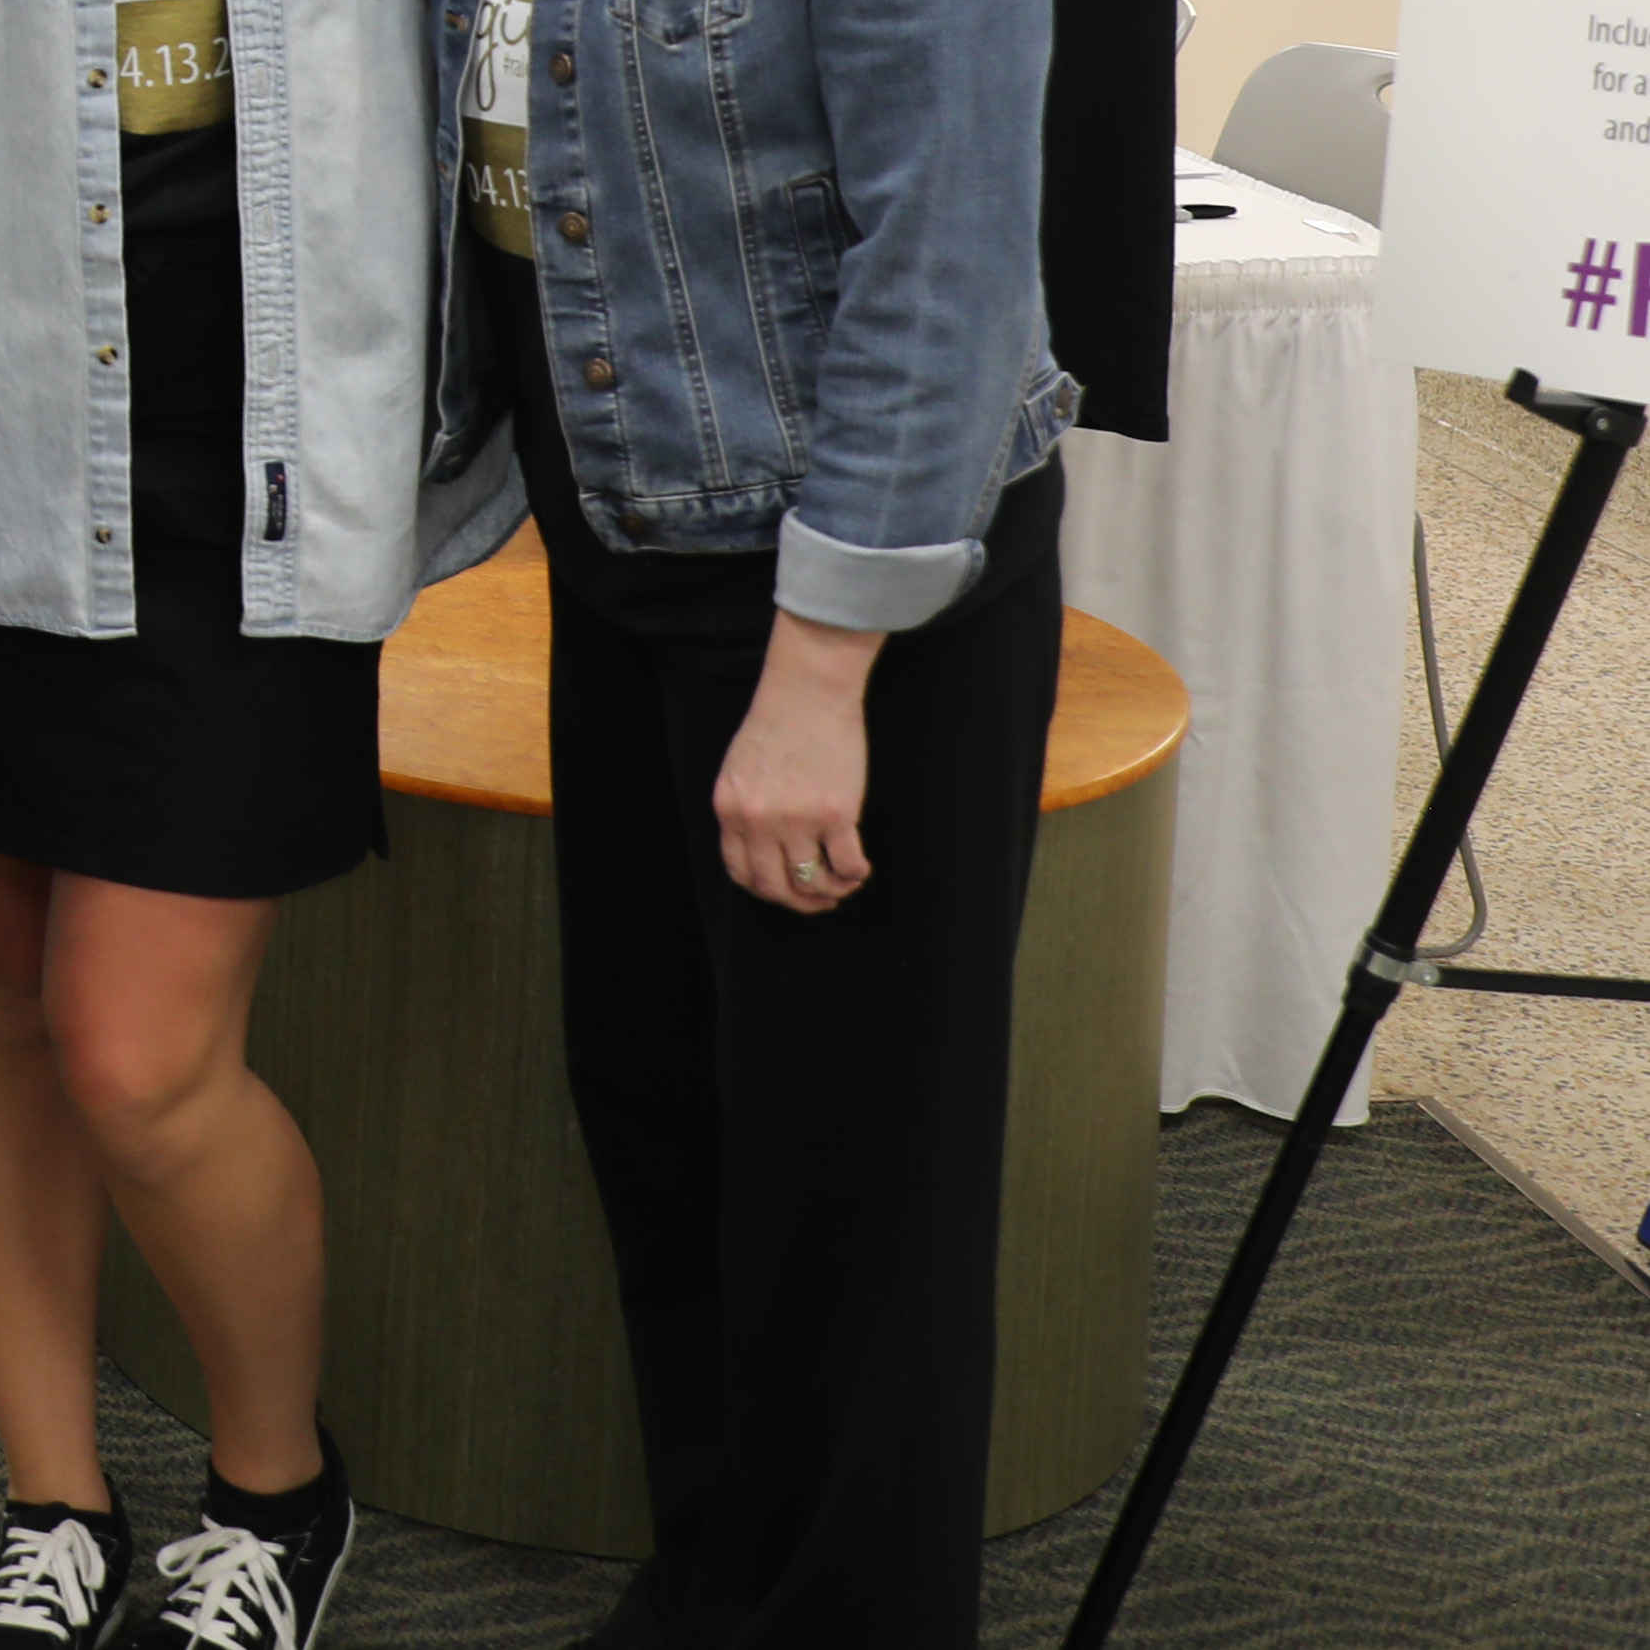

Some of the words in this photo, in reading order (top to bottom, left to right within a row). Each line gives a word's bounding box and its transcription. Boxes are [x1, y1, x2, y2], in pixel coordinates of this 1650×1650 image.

[1592, 62, 1628, 93] for
[1633, 73, 1647, 96] a
[1603, 116, 1650, 145] and
